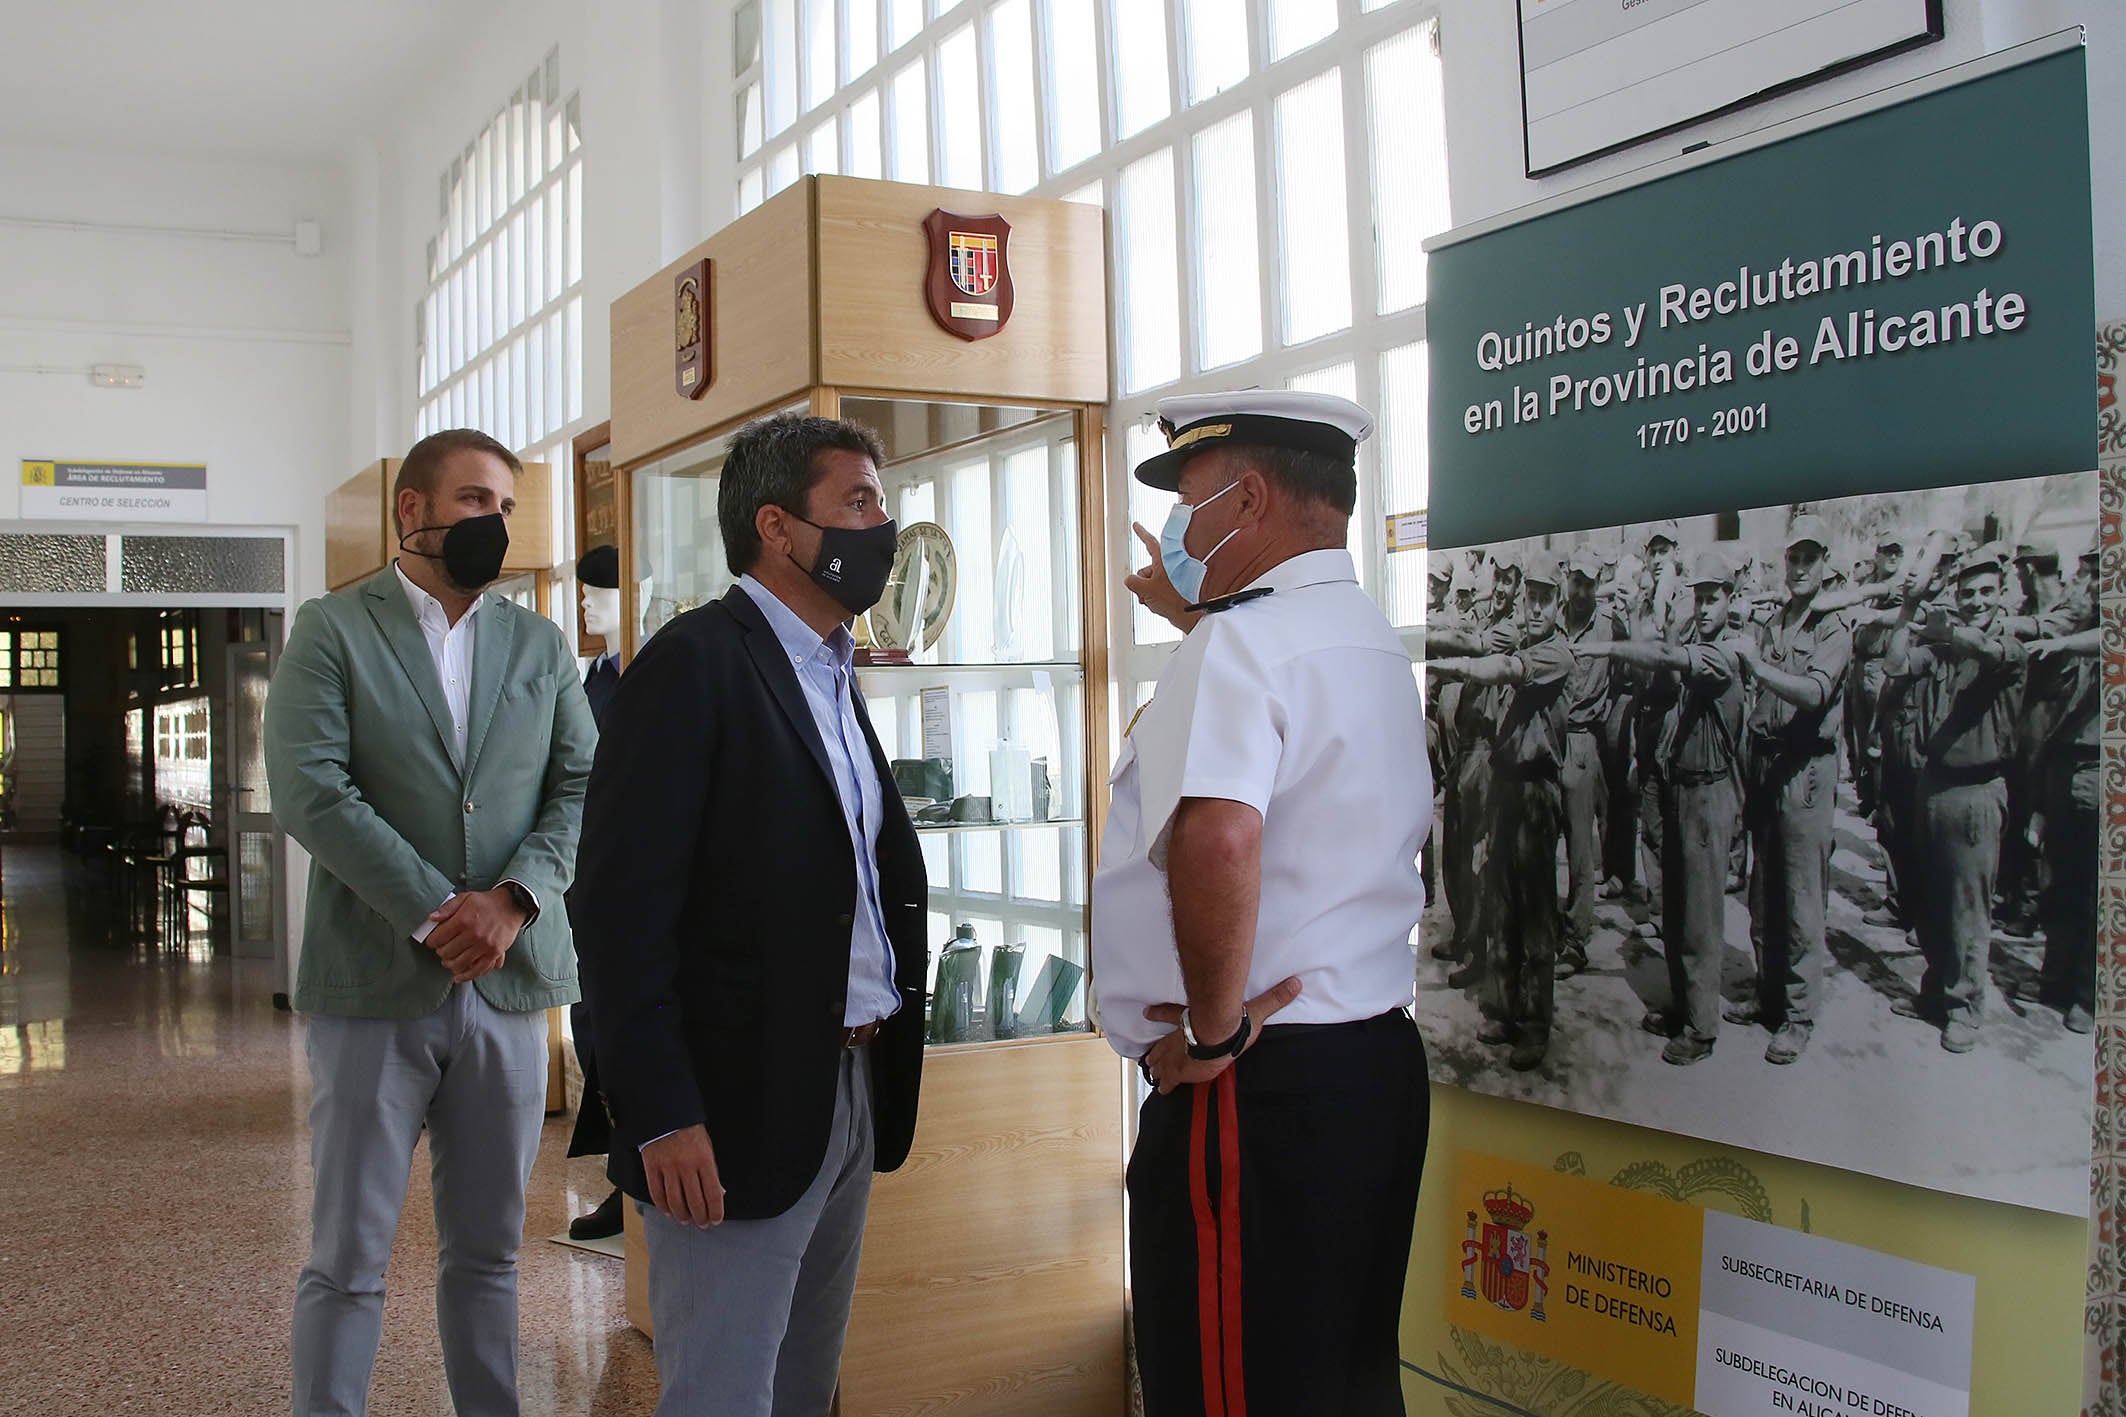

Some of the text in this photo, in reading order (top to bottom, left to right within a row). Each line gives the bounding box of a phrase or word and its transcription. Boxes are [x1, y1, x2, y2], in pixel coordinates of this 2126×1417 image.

[1476, 216, 2002, 372] Quintos y Reclutamiento
[1463, 287, 2026, 433] en la Provincia de Alicante
[1636, 403, 1769, 449] 1770 - 2001
[59, 496, 171, 509] CENTRO DE SELECCIÓN
[88, 474, 98, 482] DE
[101, 474, 165, 484] RECLUTAMIENTO
[1567, 1250, 1672, 1298] MINISTERIO
[1721, 1255, 1944, 1333] SUBSECRETARIA DE DEFENSA
[1566, 1283, 1678, 1338] DE DEFENSA
[1715, 1347, 1842, 1403] SUBDELEGACION
[1847, 1390, 1869, 1412] DE
[1772, 1390, 1793, 1411] EN
